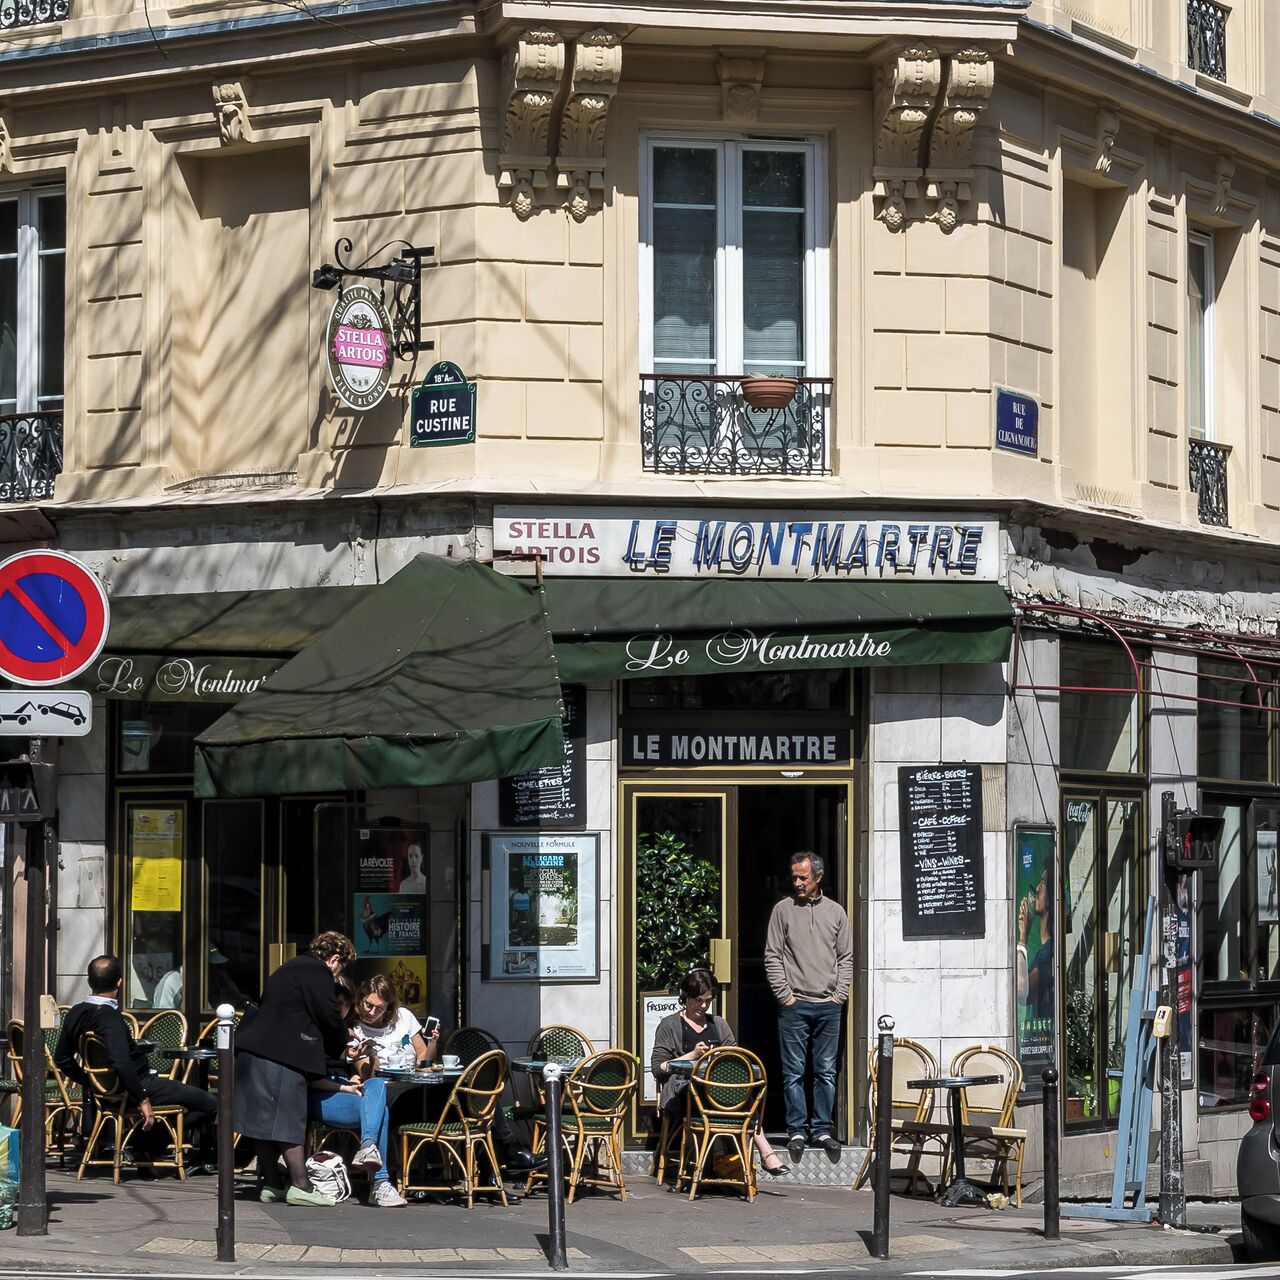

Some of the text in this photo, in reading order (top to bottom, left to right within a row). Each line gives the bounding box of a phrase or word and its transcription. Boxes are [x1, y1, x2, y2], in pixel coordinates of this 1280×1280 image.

[338, 329, 383, 347] STELLA
[338, 345, 384, 362] ARTOIS
[358, 380, 386, 405] BLONDE
[430, 398, 457, 414] RUE
[1012, 401, 1026, 416] RUE
[416, 416, 470, 433] CUSTINE
[1015, 417, 1024, 430] DE
[508, 521, 596, 540] STELLA
[622, 519, 984, 574] LE MONTMARTRE
[625, 628, 892, 671] Le Montmartre
[96, 657, 144, 694] Le
[633, 734, 836, 761] LE MONTMARTRE
[918, 814, 938, 826] CAFÉ
[388, 922, 421, 932] HISTOIRE
